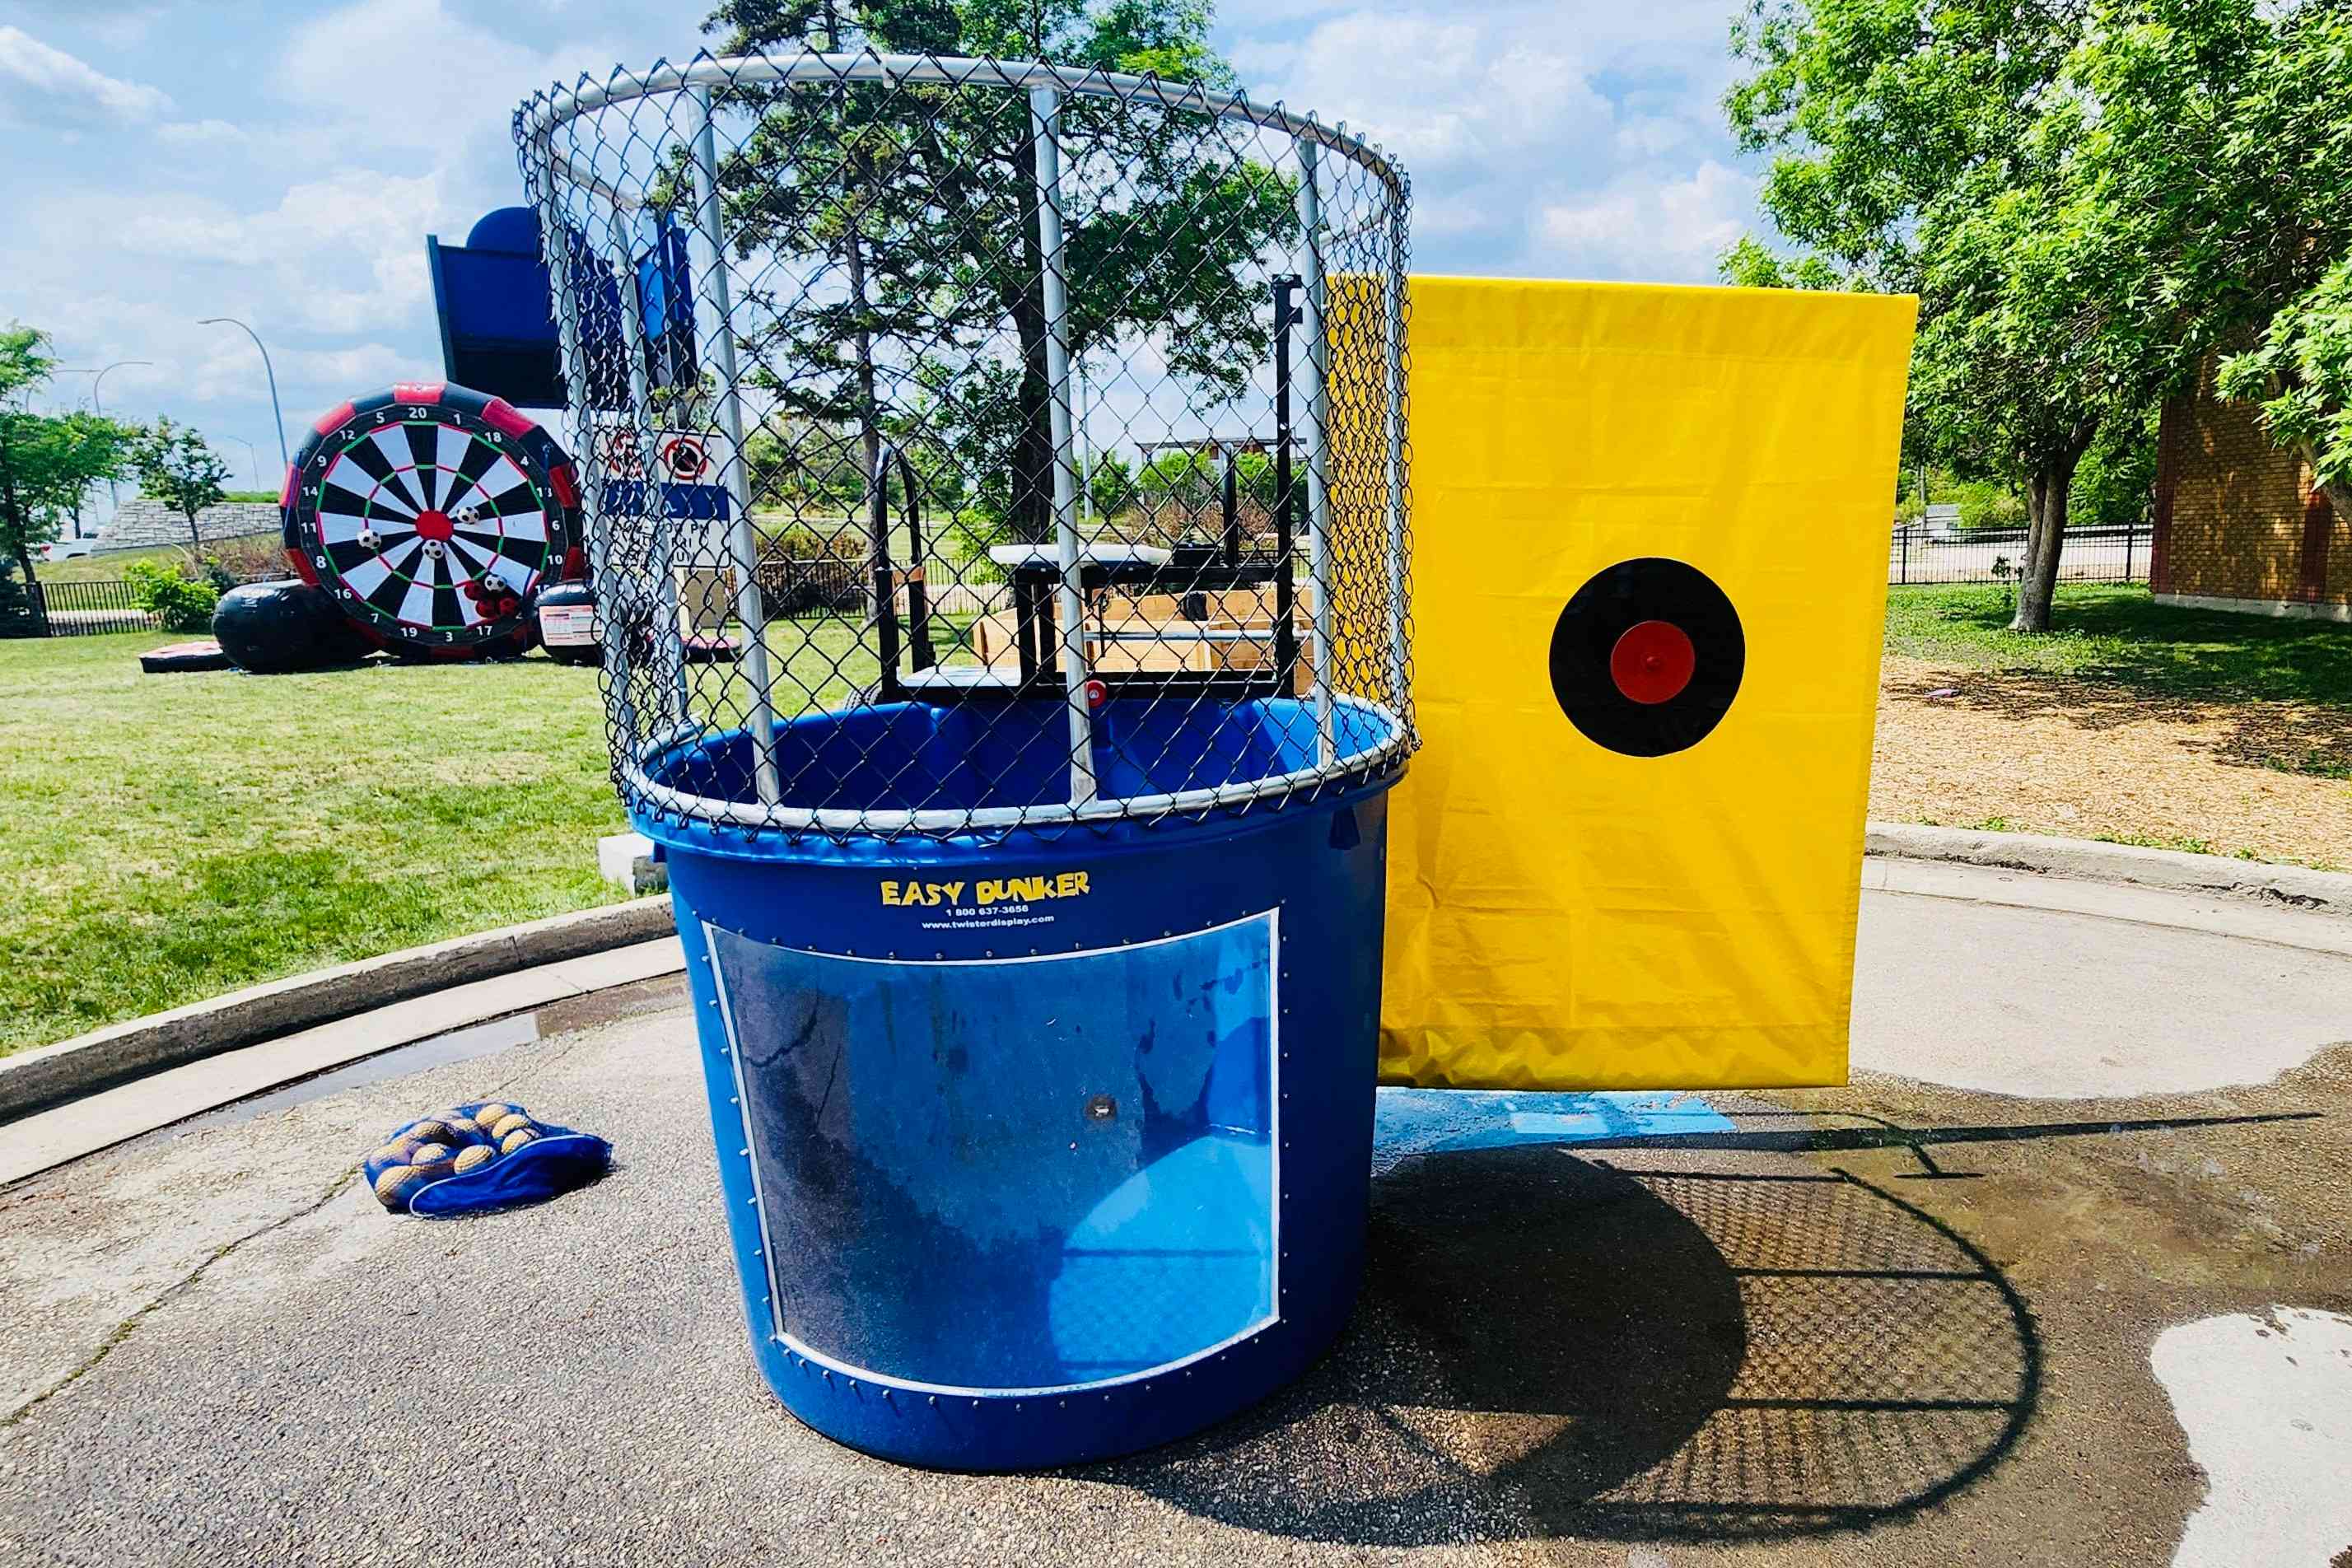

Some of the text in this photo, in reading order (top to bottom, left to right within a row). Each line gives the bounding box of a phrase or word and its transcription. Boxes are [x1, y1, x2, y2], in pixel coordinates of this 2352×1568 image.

[376, 412, 385, 424] 5
[408, 407, 427, 419] 20
[454, 413, 461, 425] 1
[339, 430, 356, 440] 12
[484, 432, 502, 443] 18
[317, 455, 327, 467] 9
[520, 455, 530, 466] 4
[302, 486, 319, 497] 14
[301, 522, 317, 534] 11
[552, 520, 560, 530] 6
[315, 555, 327, 568] 8
[547, 554, 563, 565] 10
[334, 588, 352, 600] 16
[371, 613, 379, 623] 7
[399, 627, 418, 637] 19
[476, 626, 493, 636] 17
[445, 632, 453, 642] 3
[880, 870, 1090, 906] EASY DUNKER
[945, 908, 952, 917] 1
[955, 908, 976, 917] 800
